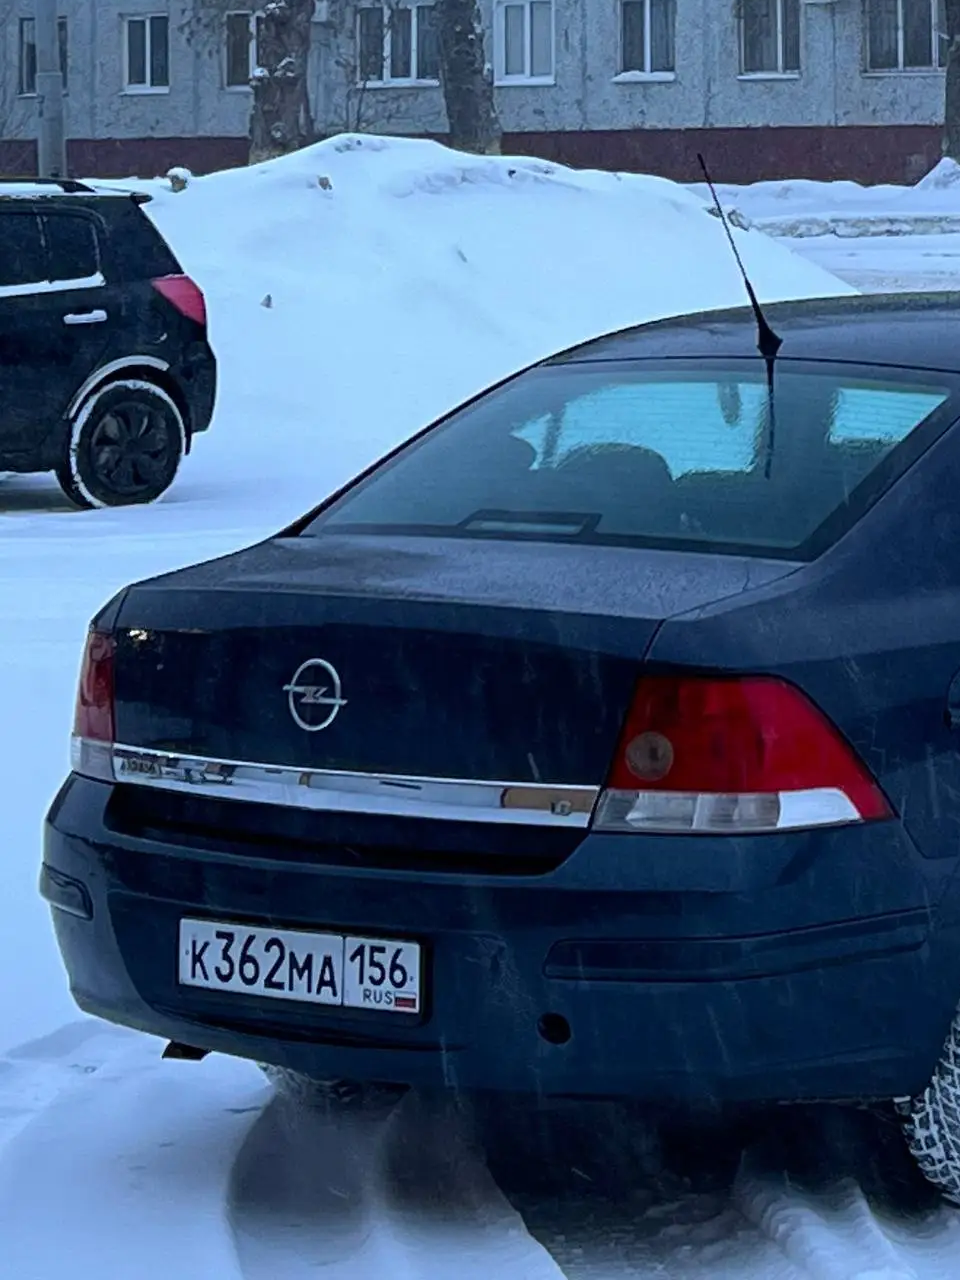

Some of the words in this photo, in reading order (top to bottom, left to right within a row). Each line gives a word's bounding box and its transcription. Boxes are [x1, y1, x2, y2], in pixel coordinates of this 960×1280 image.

[190, 930, 338, 998] К362МА
[349, 943, 408, 989] 156
[362, 988, 393, 1006] RUS
